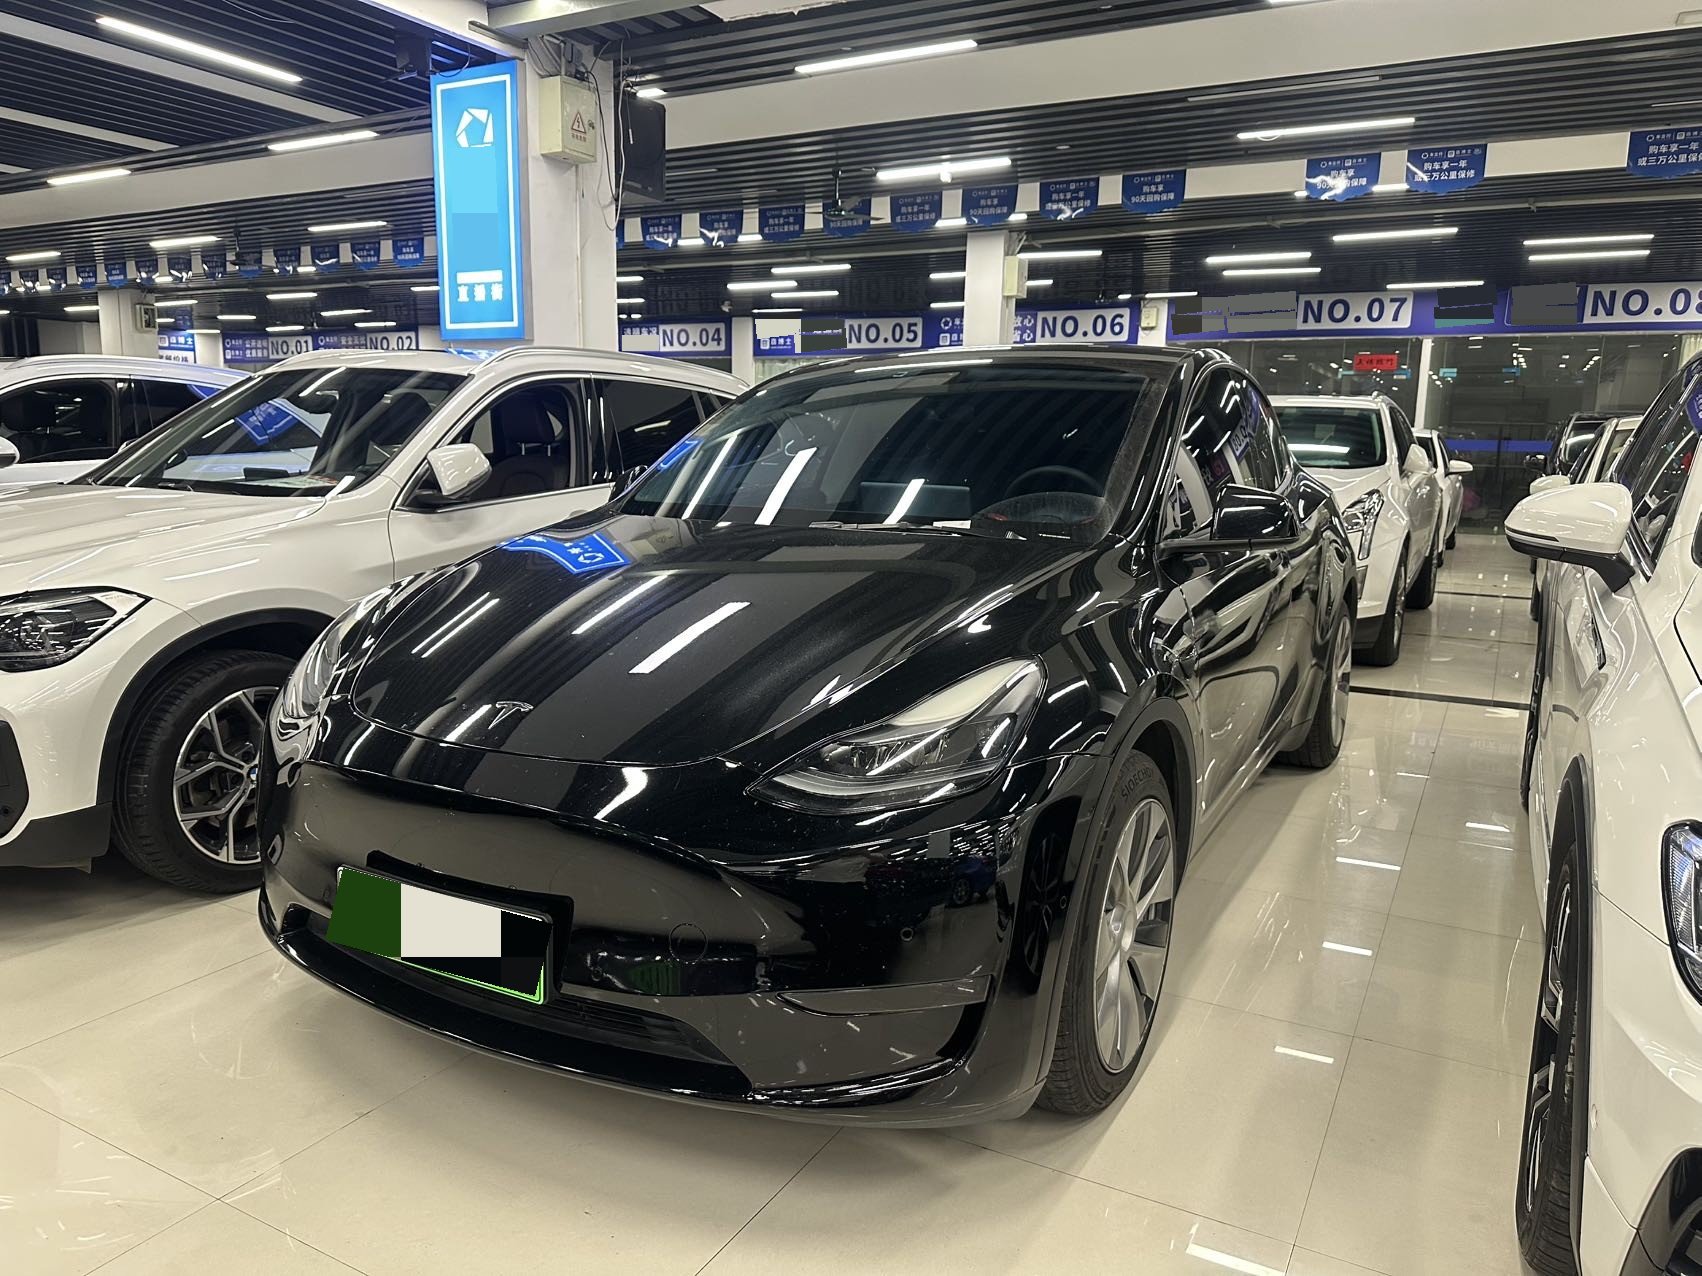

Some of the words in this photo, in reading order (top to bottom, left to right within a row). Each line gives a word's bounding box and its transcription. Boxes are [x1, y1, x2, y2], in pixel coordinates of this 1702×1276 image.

[1648, 142, 1700, 154] 购车享一年
[1423, 159, 1468, 171] 购车享一年
[1302, 297, 1408, 324] NO.07
[848, 322, 918, 344] NO.05
[1041, 313, 1125, 338] NO.06
[368, 335, 413, 351] NO.02
[662, 327, 722, 347] NO.04
[270, 339, 310, 356] NO.01
